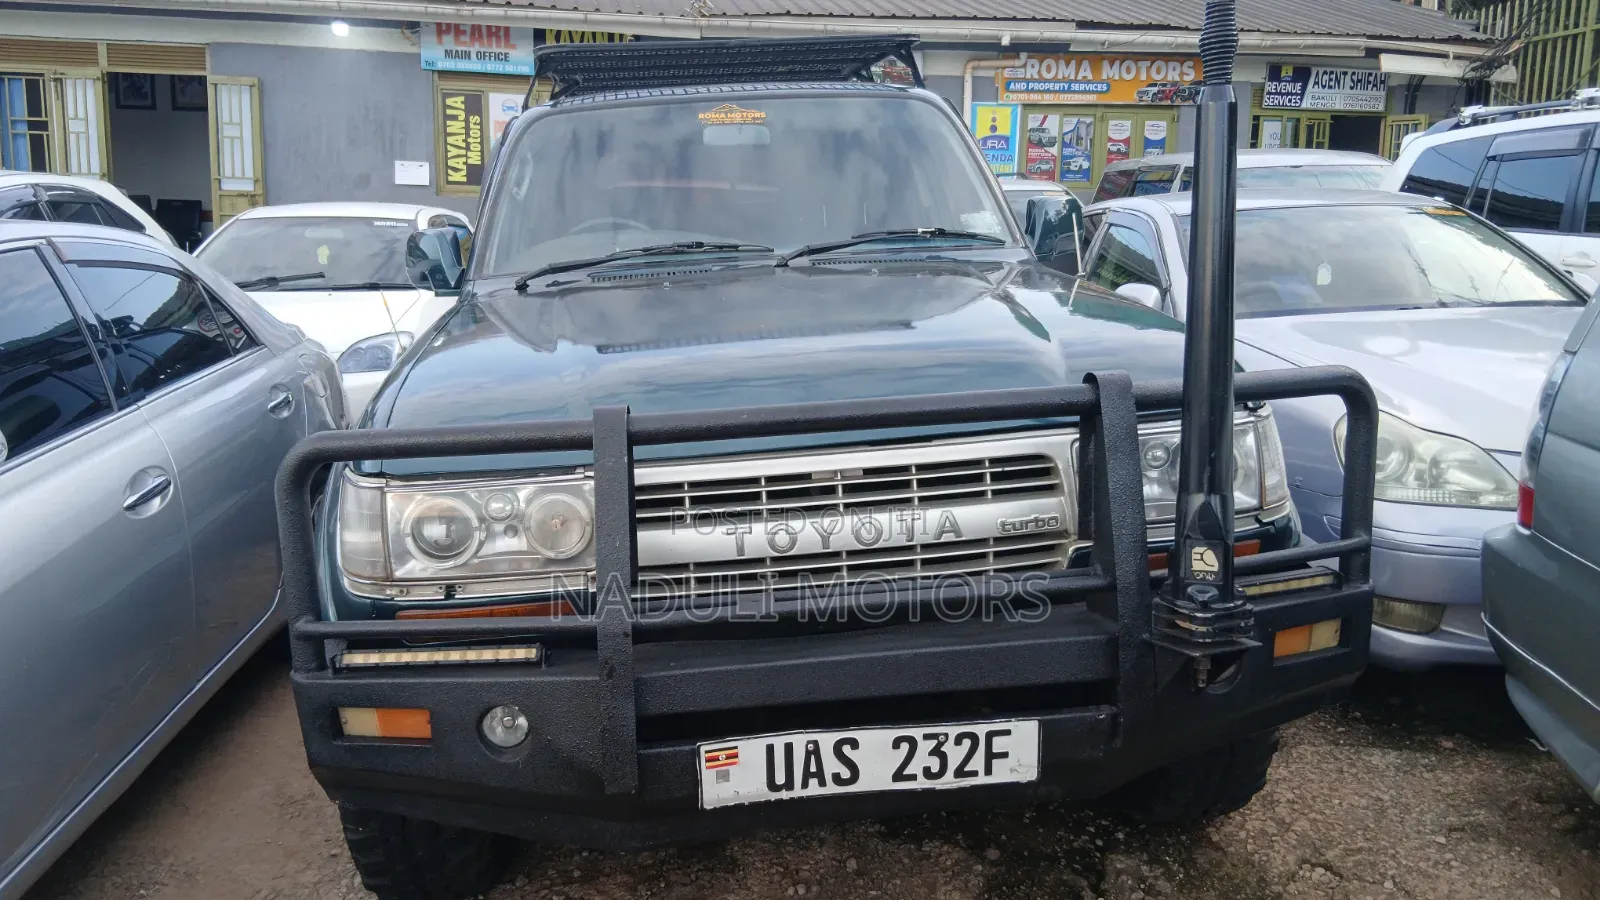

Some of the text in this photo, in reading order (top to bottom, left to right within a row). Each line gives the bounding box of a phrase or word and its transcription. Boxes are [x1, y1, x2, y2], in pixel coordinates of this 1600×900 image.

[435, 22, 517, 50] PEARL
[444, 49, 510, 62] MAIN OFFICE
[1025, 58, 1196, 82] ROMA MOTORS
[1312, 70, 1387, 92] AGENT SHIFAH
[1009, 82, 1107, 93] AND PROPERTY SERVICES
[1266, 82, 1302, 93] REVENUE
[1264, 95, 1300, 106] SERVICES
[445, 96, 467, 182] KAYANJA
[467, 115, 481, 164] Motors
[980, 140, 1007, 149] URA
[726, 509, 964, 557] TOYOTA
[997, 514, 1060, 535] turbo
[765, 729, 1012, 793] UAS 232F
